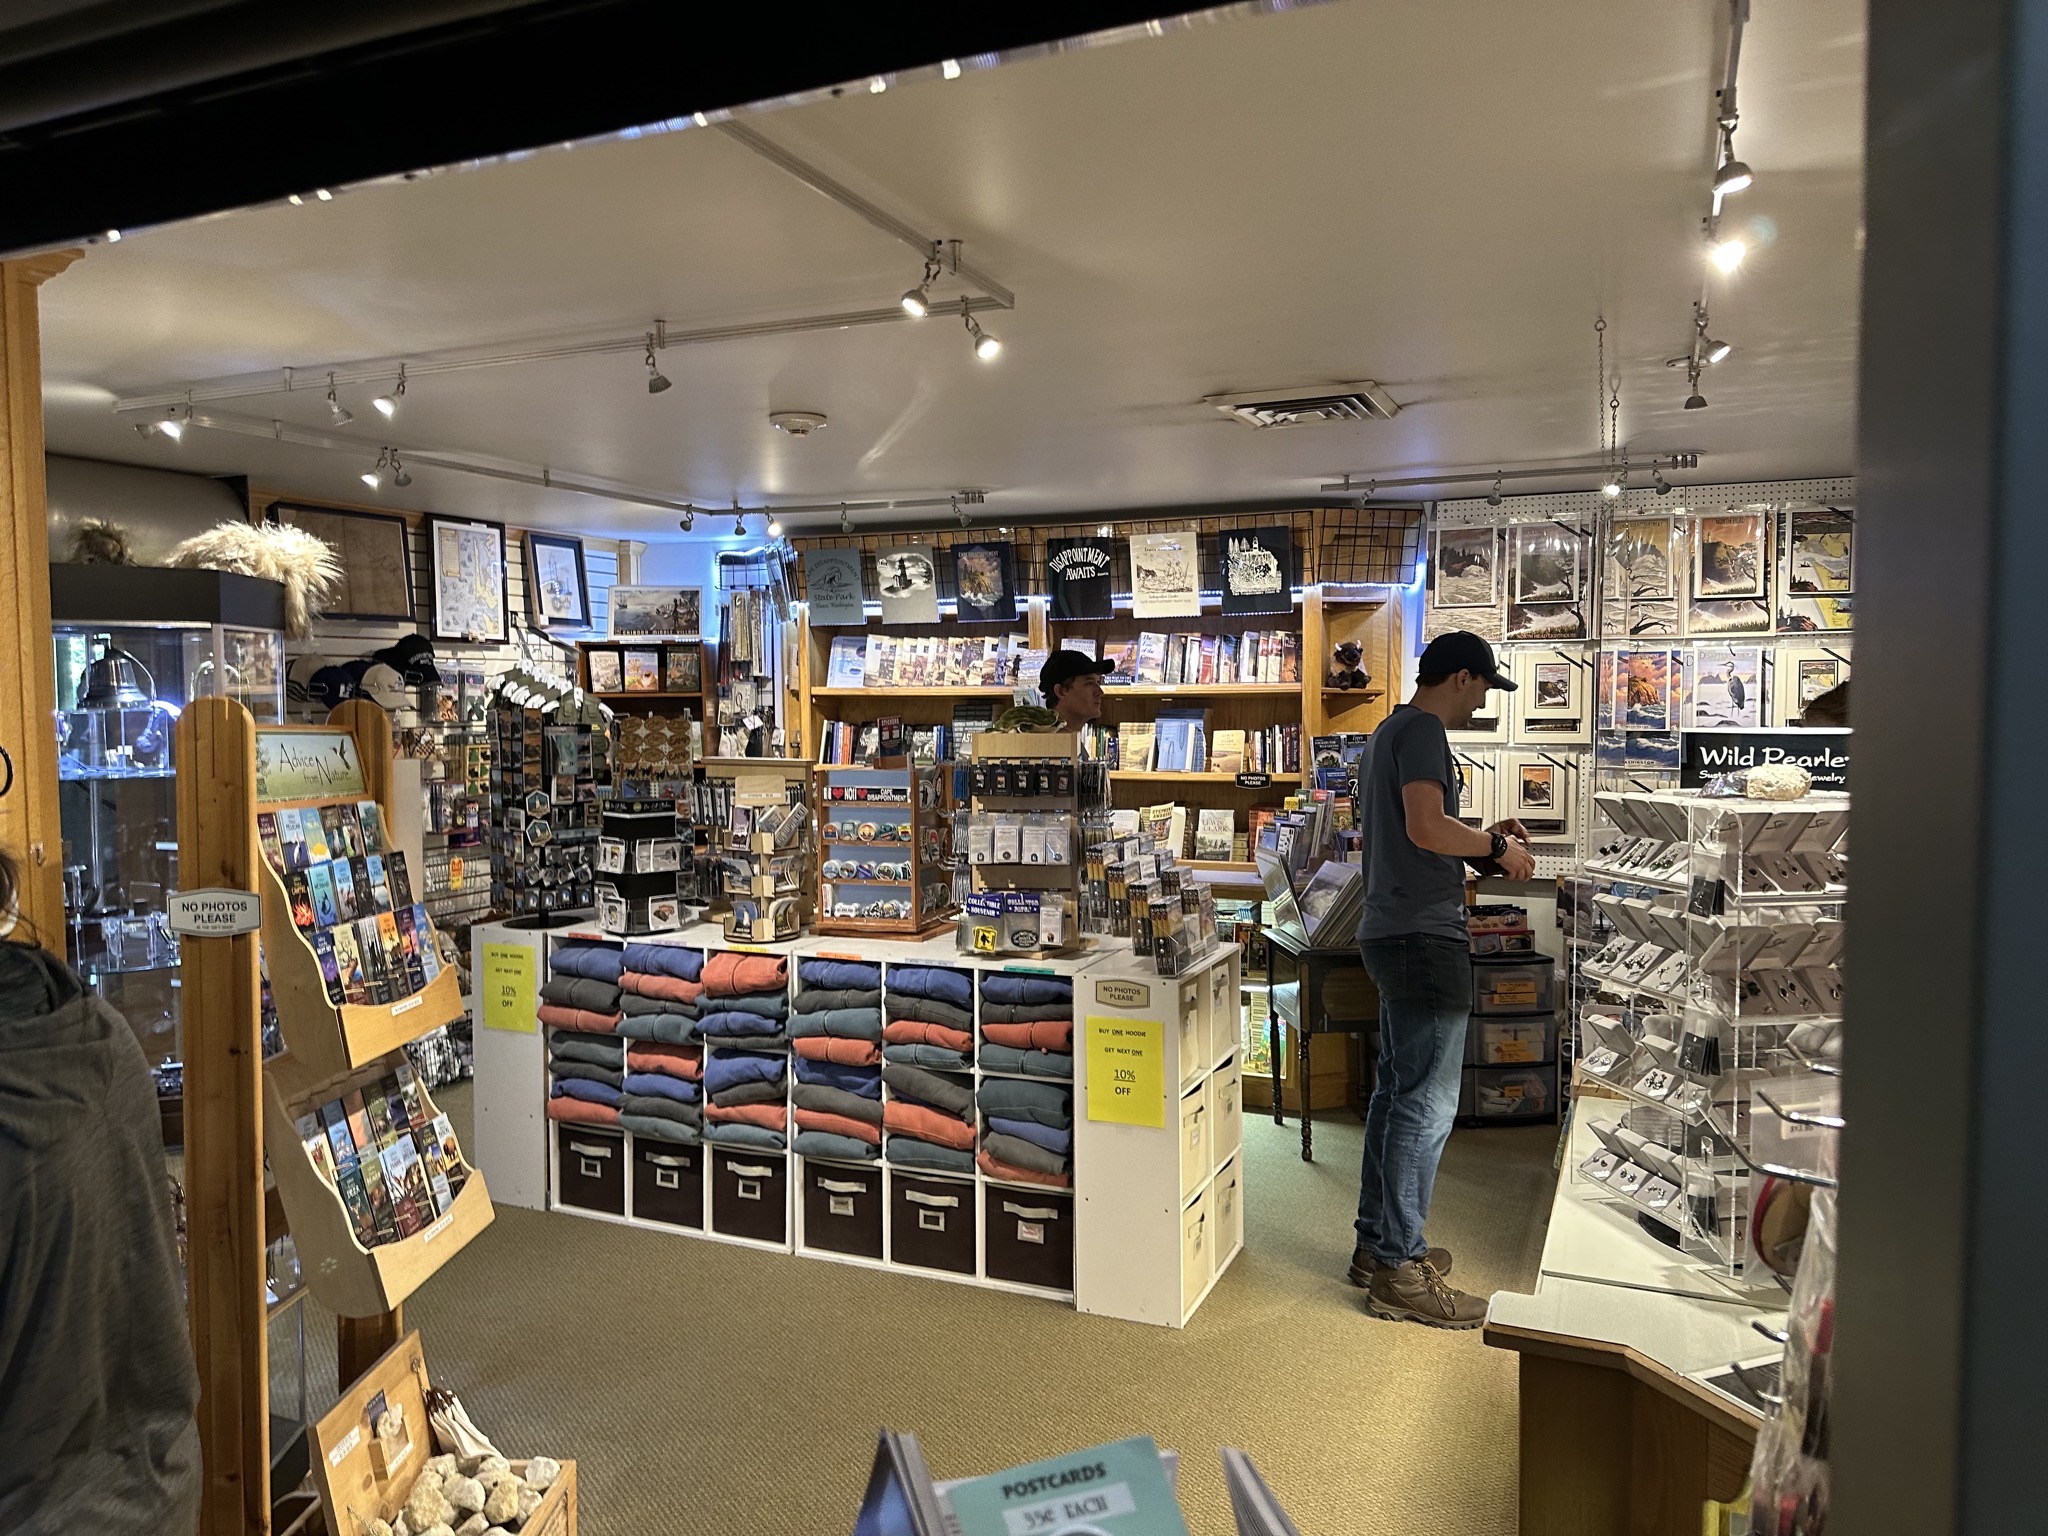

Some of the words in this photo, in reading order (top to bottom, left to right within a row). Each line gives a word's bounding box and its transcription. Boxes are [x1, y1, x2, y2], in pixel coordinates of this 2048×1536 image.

[1049, 547, 1110, 573] DISAPPOINTMENT
[1065, 566, 1096, 581] AWAITS
[815, 593, 833, 601] State
[835, 592, 855, 601] Park
[279, 742, 315, 773] Advice
[1700, 746, 1755, 767] Wild
[1762, 747, 1850, 768] Pearle
[303, 769, 319, 785] from
[315, 756, 350, 787] Nature
[880, 788, 893, 796] CAPE
[867, 794, 907, 802] DISAPPOINTMENT
[1203, 819, 1222, 827] LEWIS
[182, 902, 198, 912] NO
[201, 901, 247, 911] PHOTOS
[970, 907, 996, 917] SOUVENIR
[194, 913, 236, 924] PLEASE
[502, 985, 516, 996] 10%
[1114, 986, 1141, 996] PHOTOS
[1112, 1028, 1123, 1036] ONE
[1114, 1069, 1136, 1081] 10%
[1114, 1086, 1131, 1095] OFF
[1002, 1462, 1107, 1499] POSTCARDS
[1064, 1495, 1109, 1519] EACH
